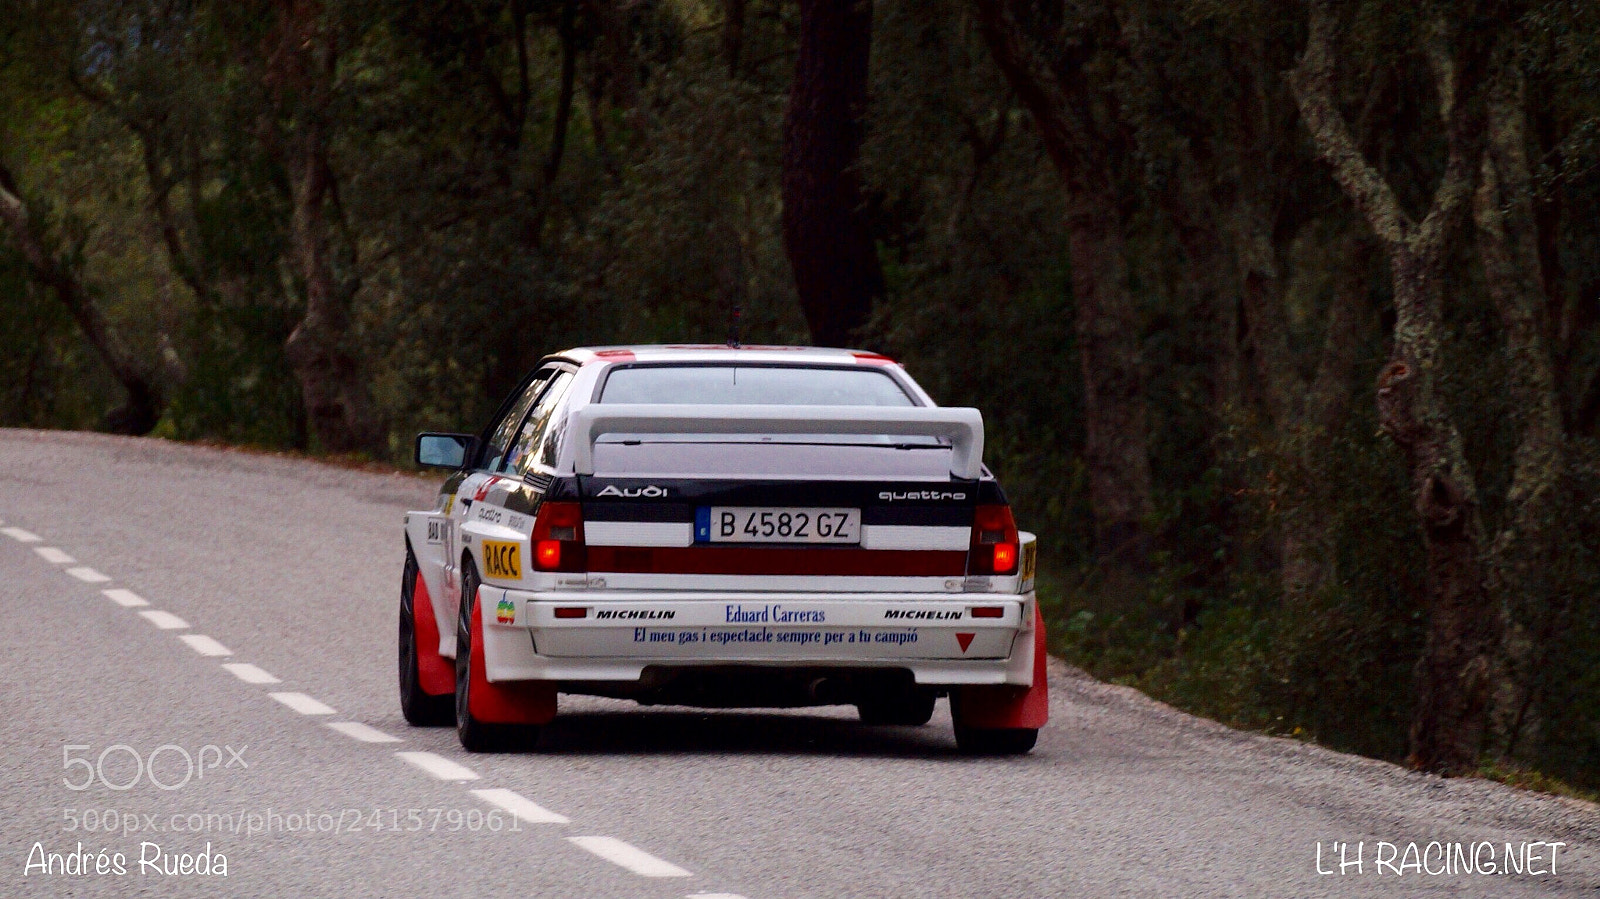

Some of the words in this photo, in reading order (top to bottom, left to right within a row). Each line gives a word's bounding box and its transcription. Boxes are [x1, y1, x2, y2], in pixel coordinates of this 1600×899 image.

[878, 490, 967, 502] quattro
[720, 512, 736, 537] B
[744, 512, 810, 538] 4582
[817, 513, 849, 538] GZ
[484, 543, 518, 577] RACC
[596, 610, 676, 620] MICHELIN
[726, 605, 769, 623] Eduard
[772, 605, 826, 623] Carreras
[884, 610, 963, 620] MICHELIN
[633, 627, 646, 643] El
[650, 630, 675, 643] meu
[678, 630, 699, 645] gas
[702, 627, 707, 643] i
[710, 627, 773, 646] espectacle
[776, 630, 820, 646] sempre
[824, 630, 846, 646] per
[848, 631, 855, 643] a
[859, 629, 871, 643] tu
[874, 628, 918, 646] campió
